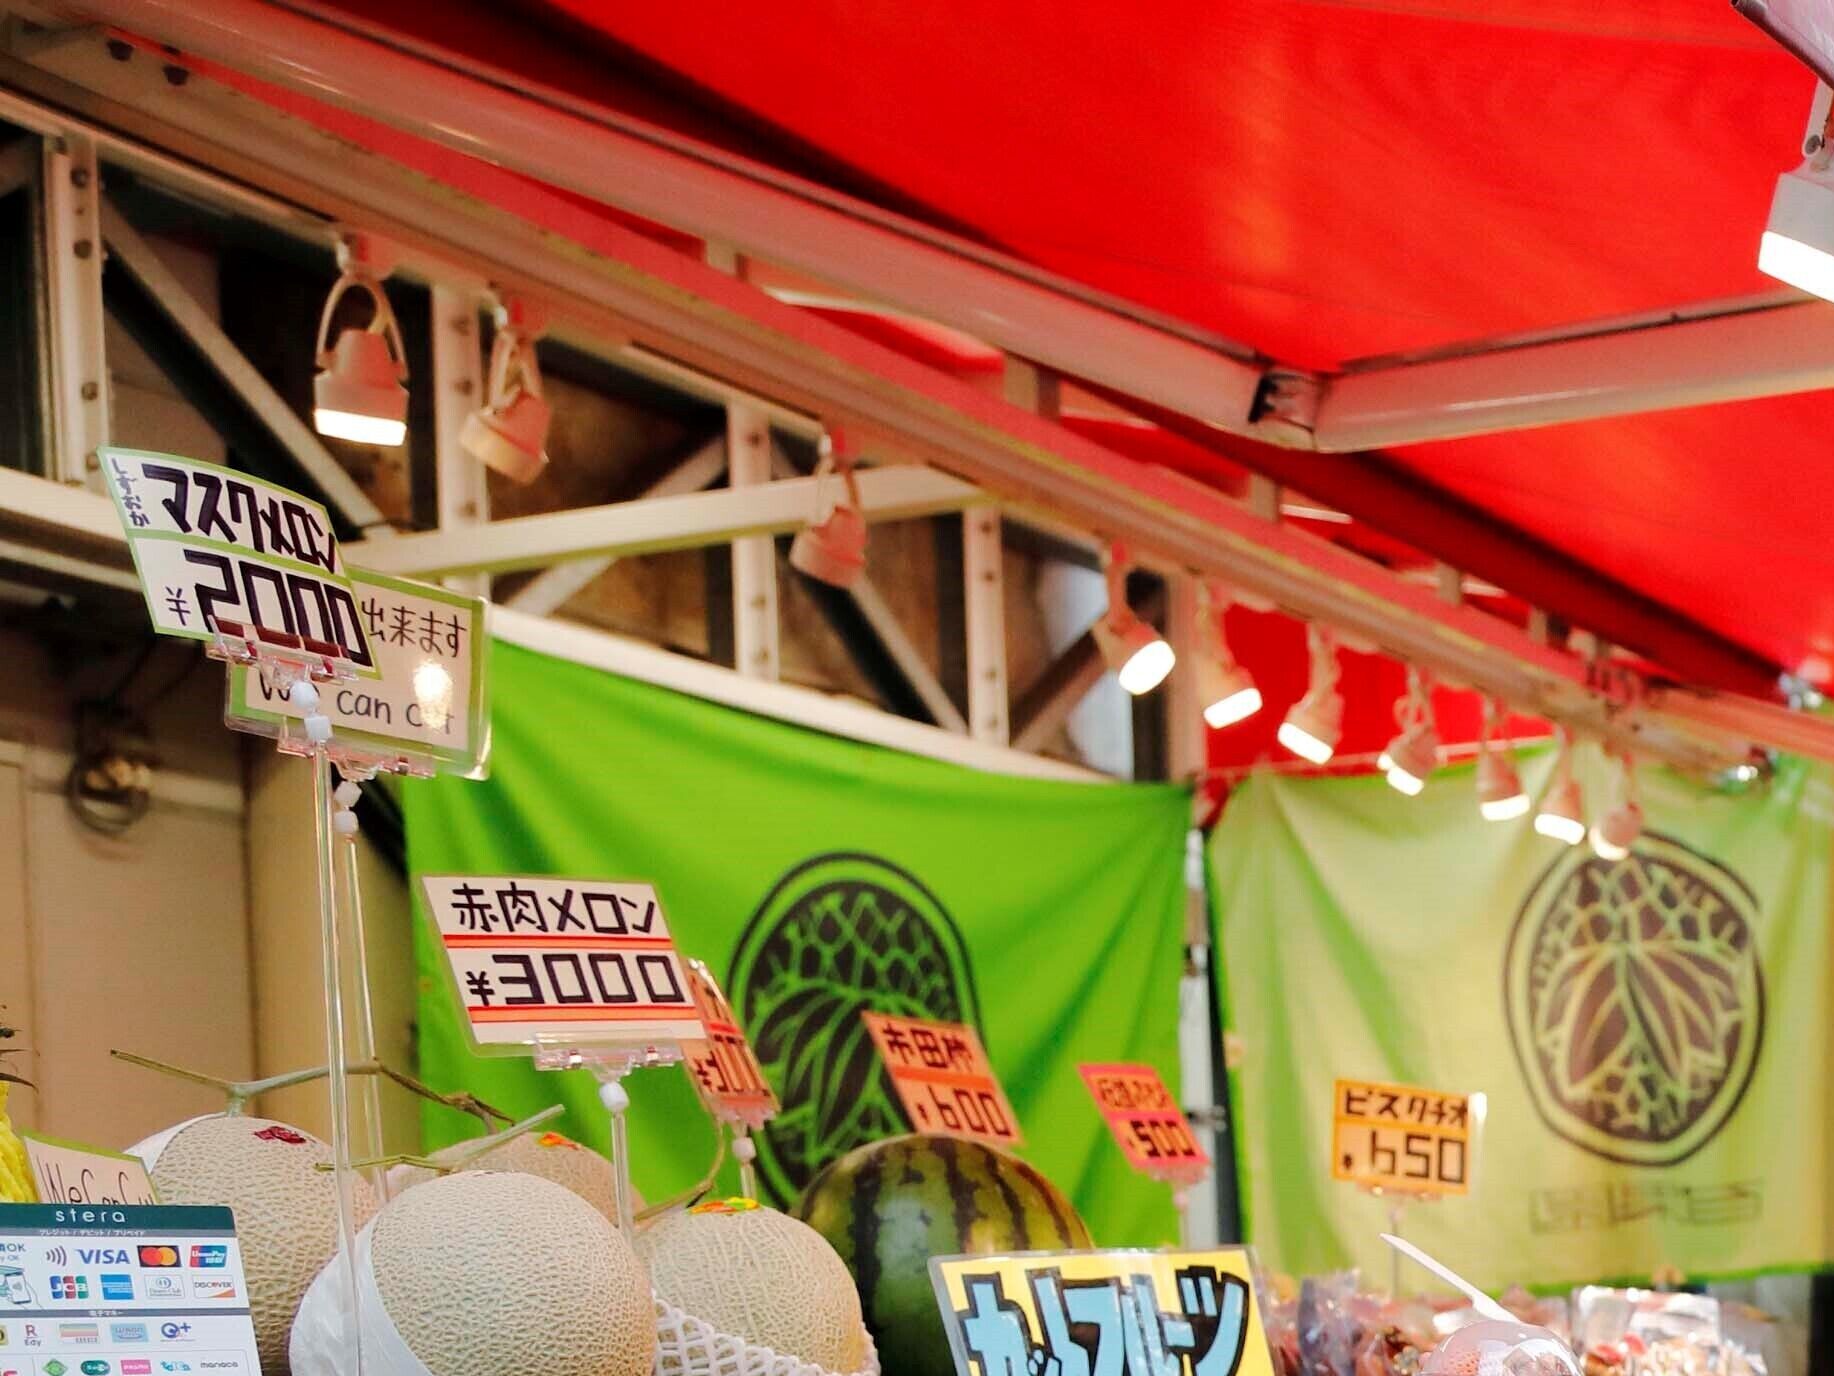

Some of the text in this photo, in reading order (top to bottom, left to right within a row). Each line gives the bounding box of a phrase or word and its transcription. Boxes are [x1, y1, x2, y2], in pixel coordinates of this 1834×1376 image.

[141, 463, 335, 574] マスクメロン
[166, 549, 373, 667] ¥2000
[361, 598, 467, 658] 出来ます
[337, 690, 391, 724] can
[453, 883, 654, 934] 赤肉メロン
[466, 954, 685, 1005] ¥3000
[56, 1208, 125, 1222] stera
[76, 1249, 130, 1264] VISA
